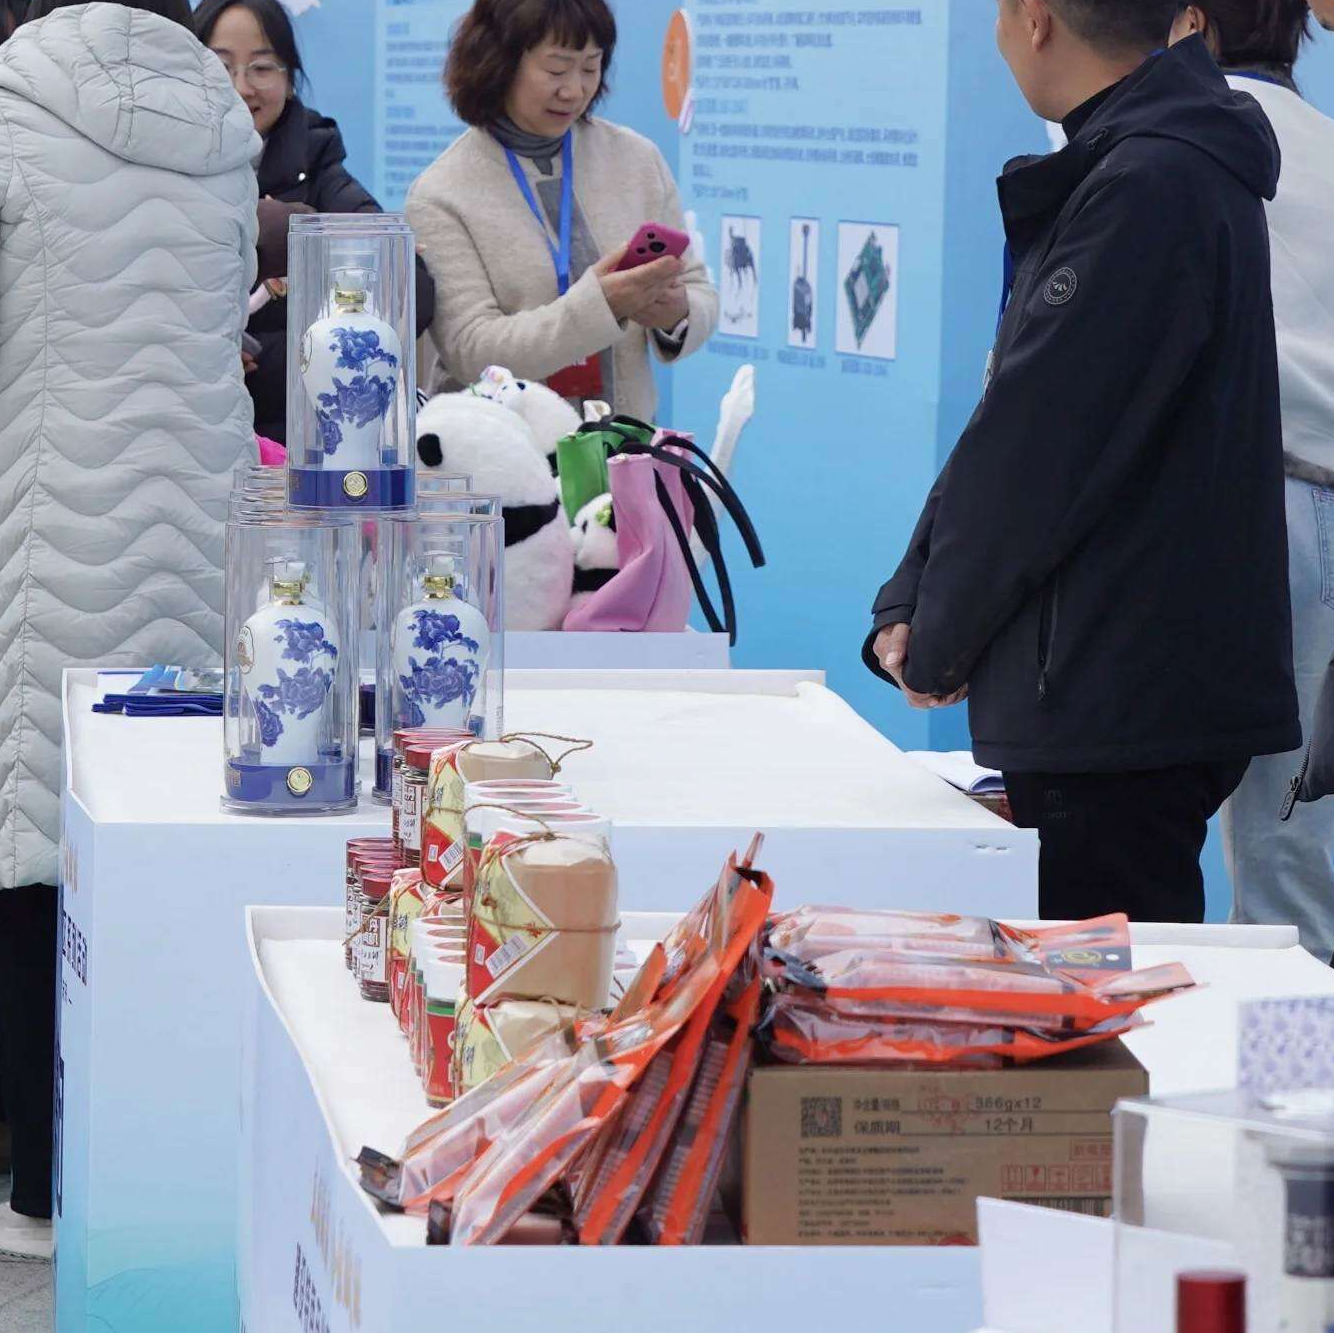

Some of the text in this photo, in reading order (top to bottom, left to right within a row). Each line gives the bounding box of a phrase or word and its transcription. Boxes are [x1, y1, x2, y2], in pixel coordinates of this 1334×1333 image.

[854, 1119, 1034, 1135] 保质期 12个月
